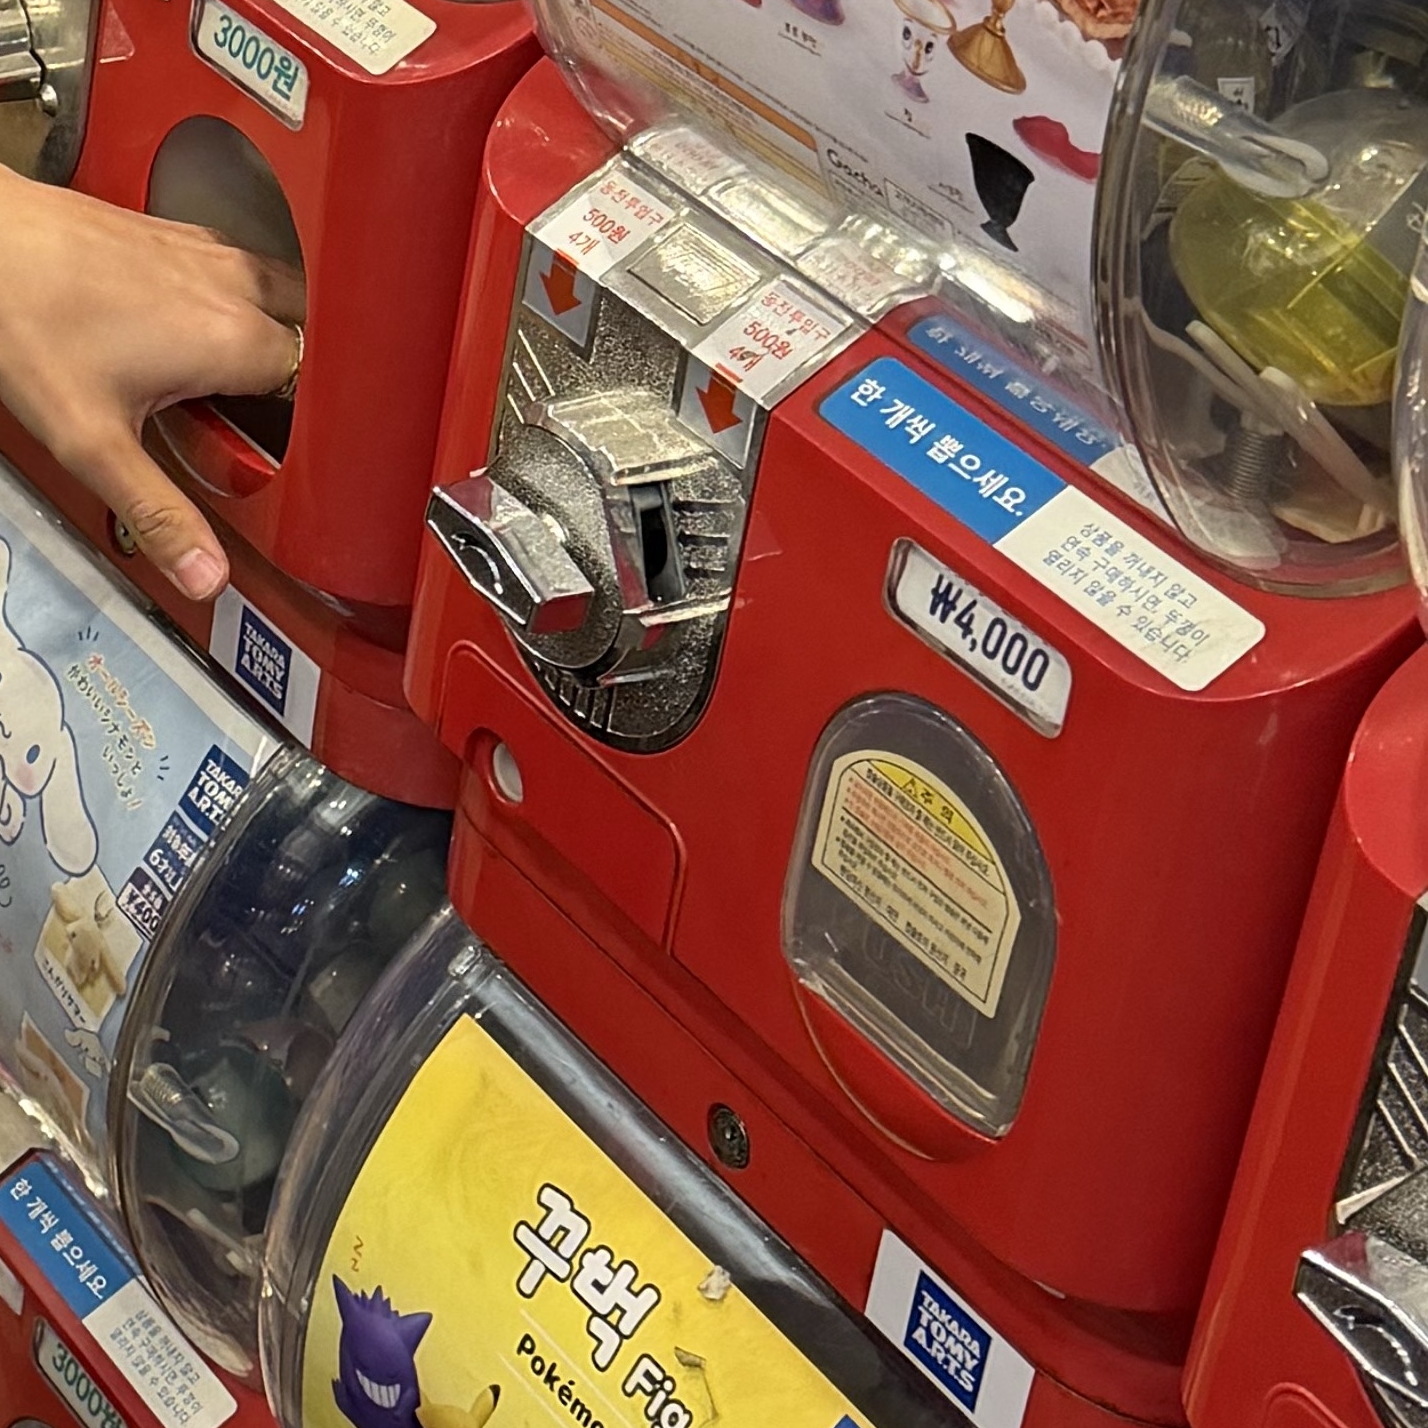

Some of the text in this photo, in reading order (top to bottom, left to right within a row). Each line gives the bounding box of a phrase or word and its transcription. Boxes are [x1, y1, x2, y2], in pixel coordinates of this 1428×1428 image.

[213, 14, 300, 102] 3000원
[581, 207, 632, 244] 500원
[598, 179, 666, 228] 동전투입구
[567, 230, 600, 257] 4개
[742, 320, 793, 361] 500원
[851, 377, 1030, 518] 한 개씩 뽑으세요.
[1042, 549, 1087, 588] 열리지
[1082, 579, 1119, 608] 않을
[1115, 602, 1133, 619] 수
[1060, 535, 1091, 566] 연속
[1080, 522, 1200, 610] 상품을 꺼내지 않고
[929, 571, 1051, 692] ₩4,000
[10, 1177, 33, 1201] 한
[26, 1195, 61, 1235] 개씩
[513, 1182, 661, 1371] 꾸벅
[916, 1308, 980, 1372] TOMY
[920, 1289, 981, 1362] TAKARA
